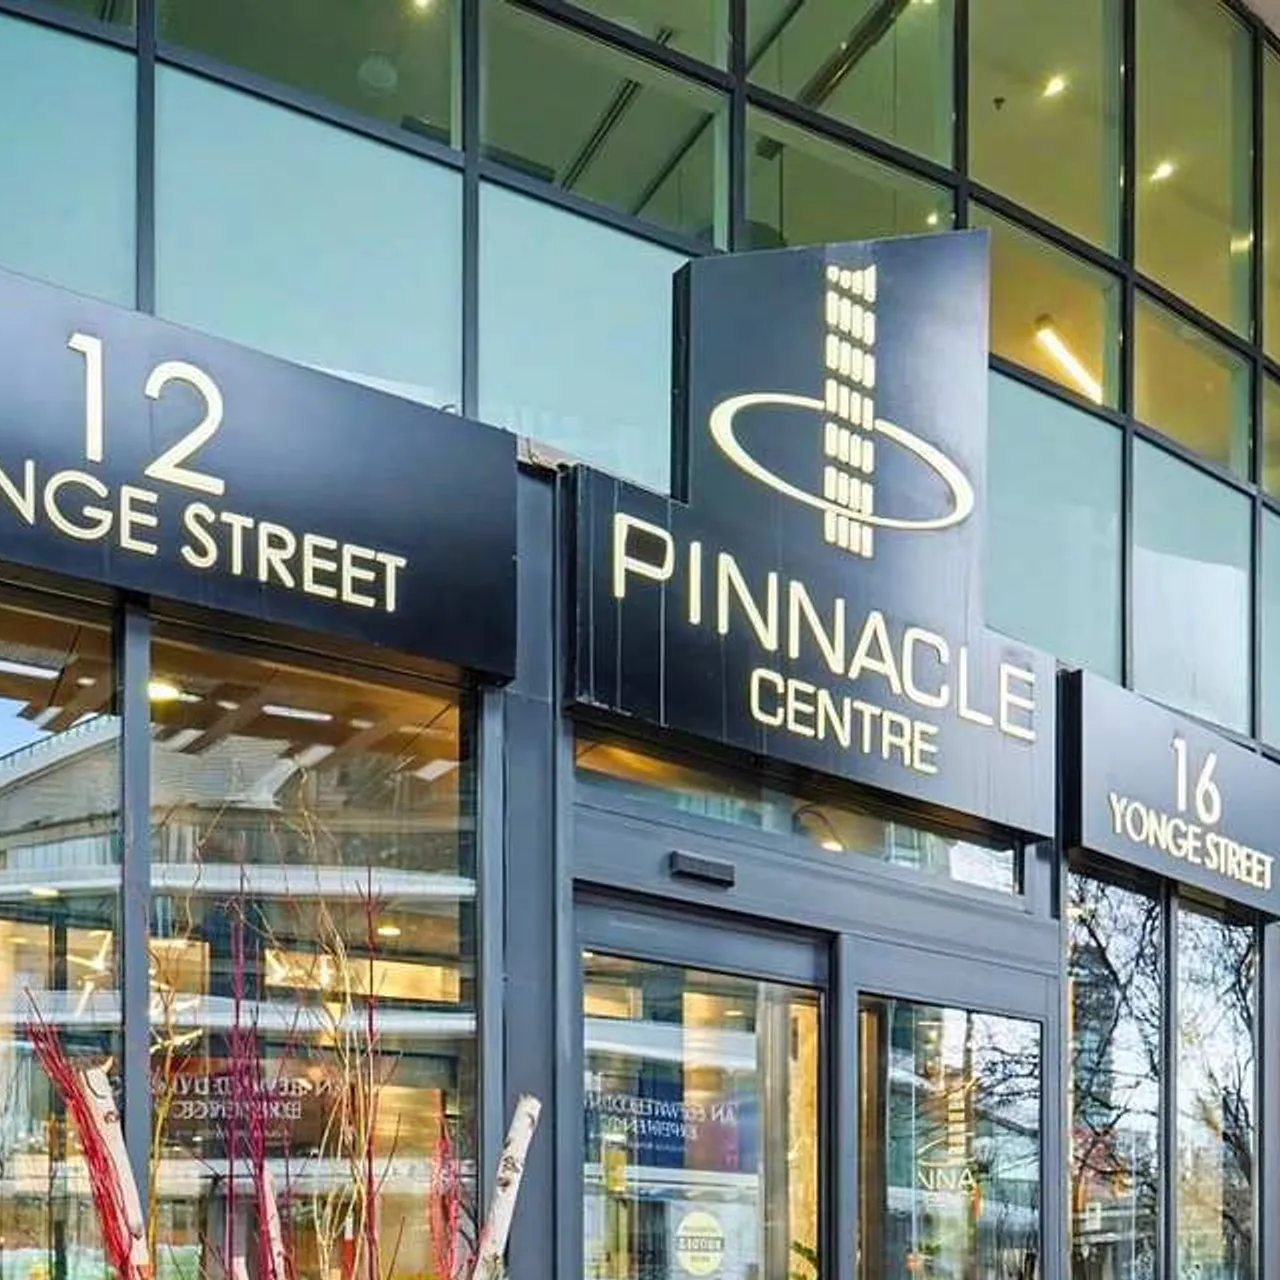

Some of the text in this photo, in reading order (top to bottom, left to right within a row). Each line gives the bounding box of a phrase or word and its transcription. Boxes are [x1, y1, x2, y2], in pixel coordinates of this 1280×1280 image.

[66, 331, 226, 496] 12
[180, 501, 407, 614] STREET
[613, 512, 1037, 742] PINNACLE
[750, 667, 940, 775] CENTRE
[1171, 736, 1222, 825] 16
[1108, 791, 1276, 891] YONGE STREET
